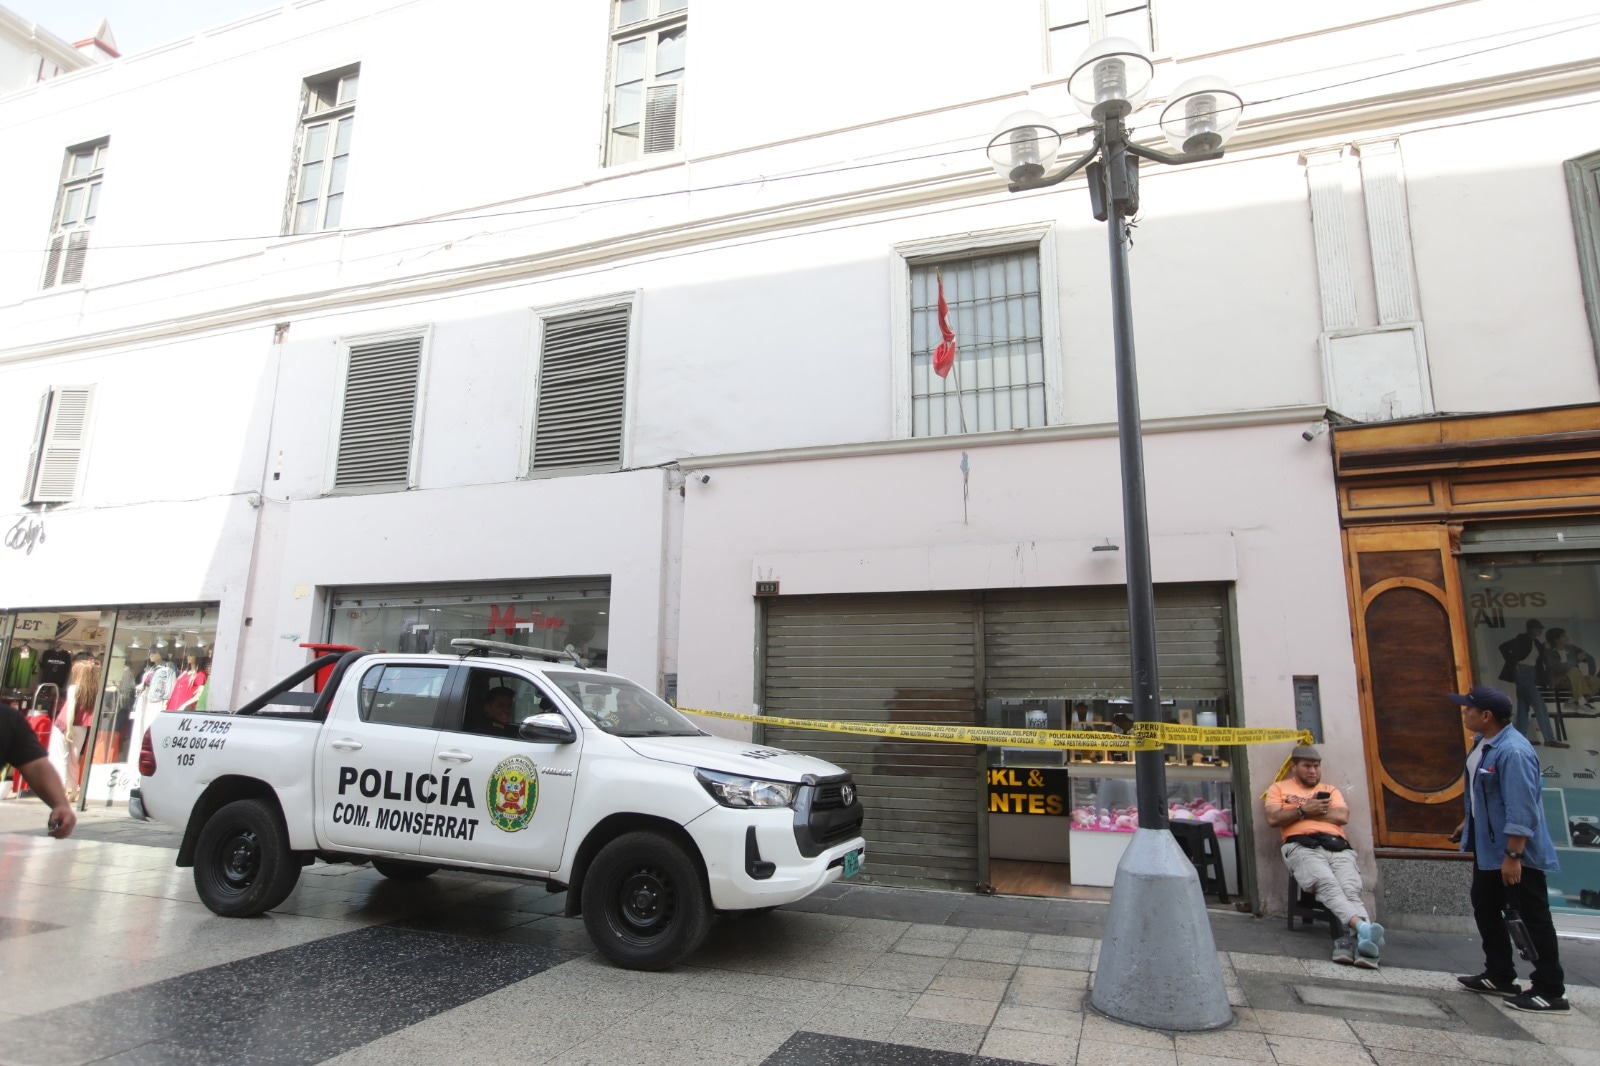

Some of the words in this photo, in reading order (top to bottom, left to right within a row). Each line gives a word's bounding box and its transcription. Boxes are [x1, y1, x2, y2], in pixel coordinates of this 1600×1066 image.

[178, 719, 193, 732] KL
[199, 719, 232, 735] 27856
[172, 736, 188, 749] 942
[190, 738, 207, 749] 080
[208, 739, 227, 750] 441
[177, 754, 195, 766] 105
[1028, 768, 1045, 787] &
[338, 766, 476, 809] POLICÍA
[987, 792, 1063, 815] NTES
[332, 802, 371, 828] COM.
[375, 807, 479, 841] MONSERRAT
